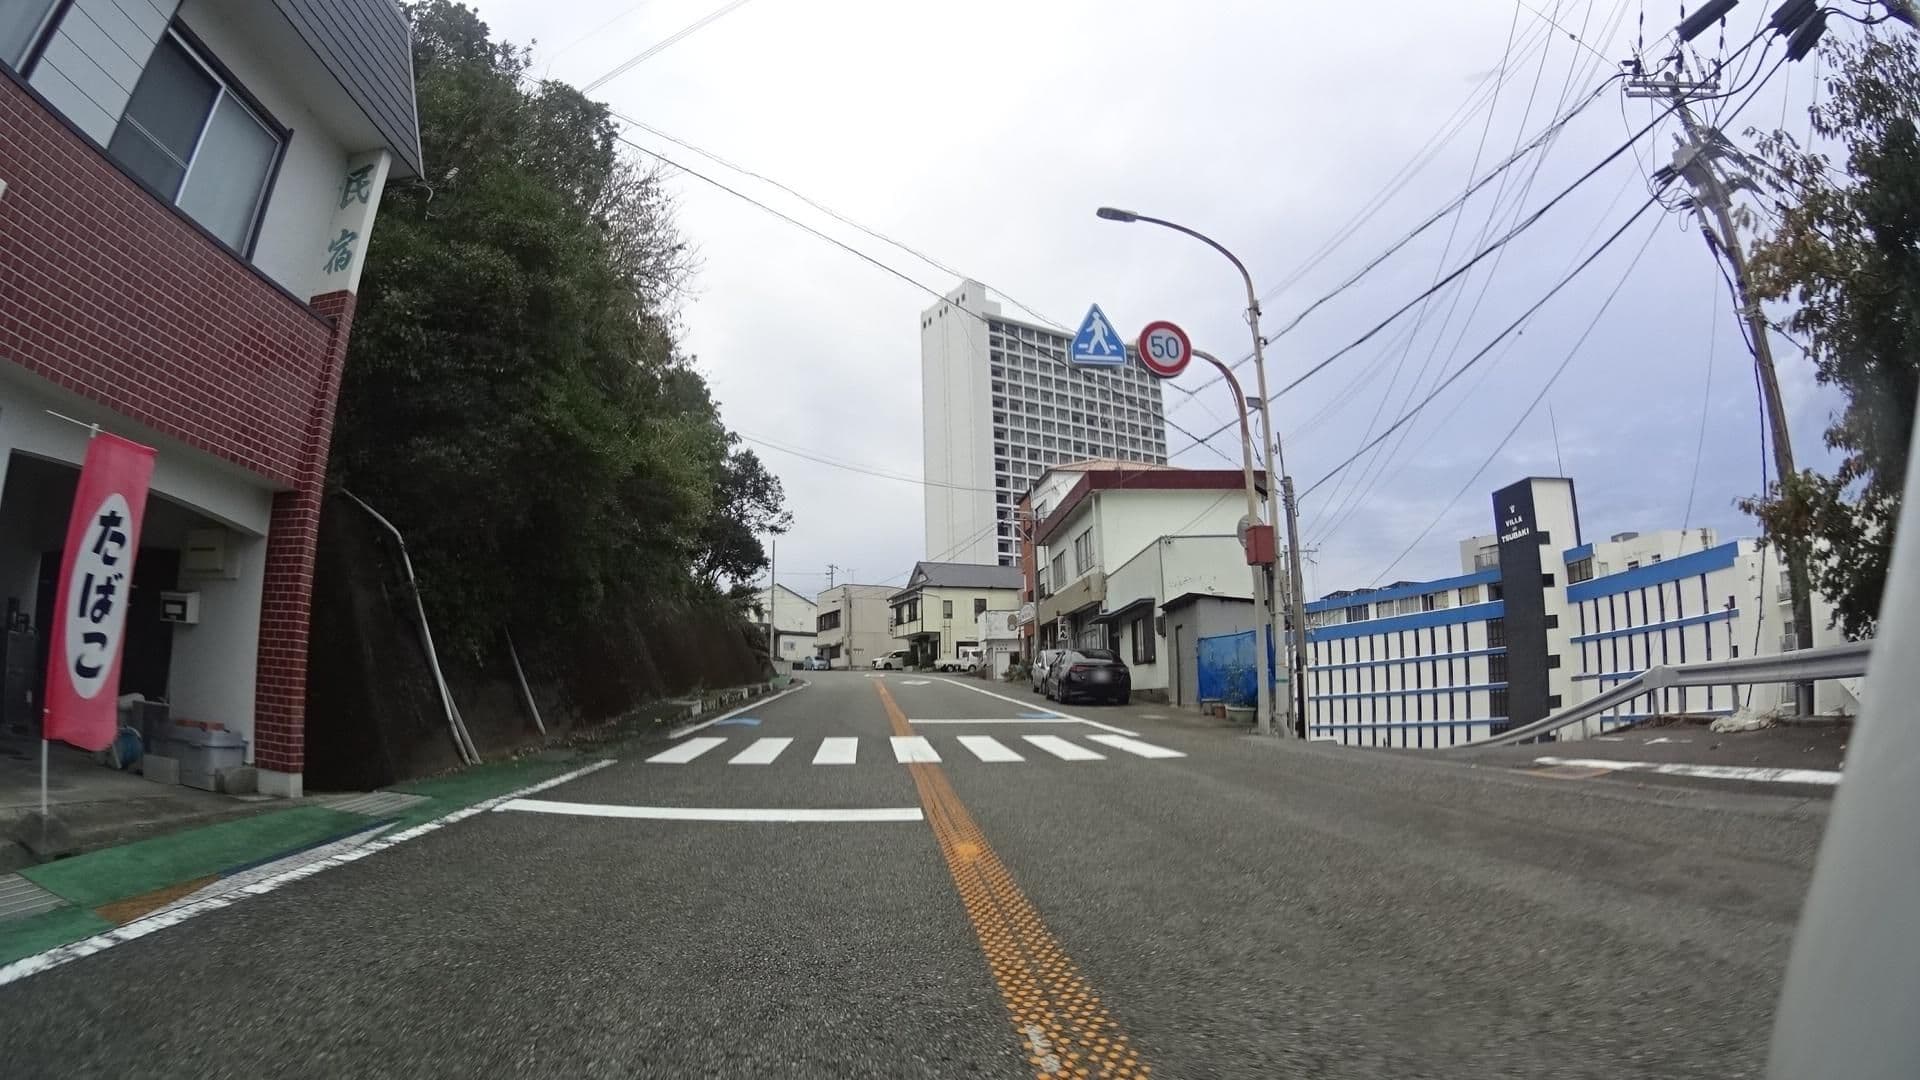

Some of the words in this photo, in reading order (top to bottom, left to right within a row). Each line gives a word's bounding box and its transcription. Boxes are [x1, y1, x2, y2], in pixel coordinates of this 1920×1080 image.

[322, 164, 375, 275] 民宿
[1151, 335, 1180, 359] 50
[1504, 515, 1523, 528] VILLA
[1501, 527, 1530, 543] TSUBAKI
[74, 510, 127, 679] たばこ
